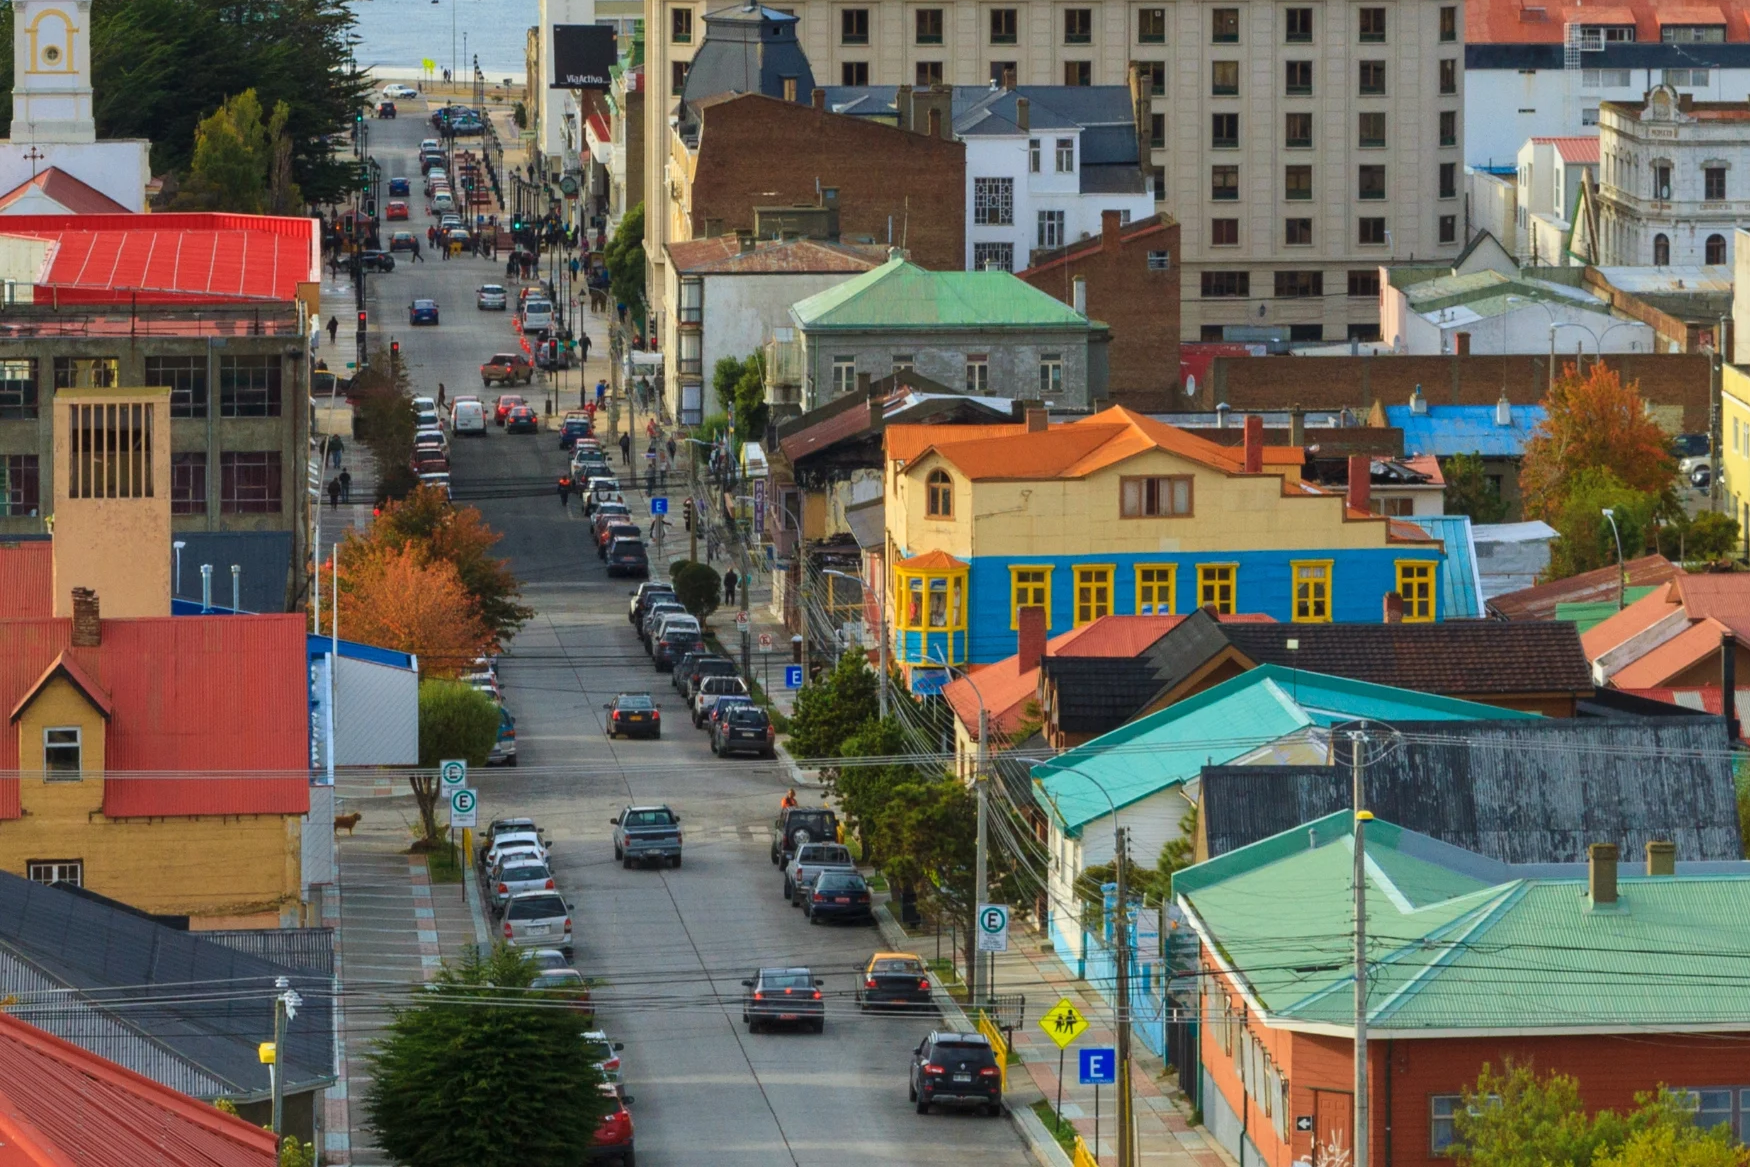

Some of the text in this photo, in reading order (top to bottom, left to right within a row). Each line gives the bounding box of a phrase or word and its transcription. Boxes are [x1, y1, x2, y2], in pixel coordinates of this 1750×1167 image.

[792, 671, 801, 684] E
[449, 766, 458, 779] E
[459, 795, 468, 808] E
[987, 912, 998, 928] E
[1090, 1055, 1104, 1077] E
